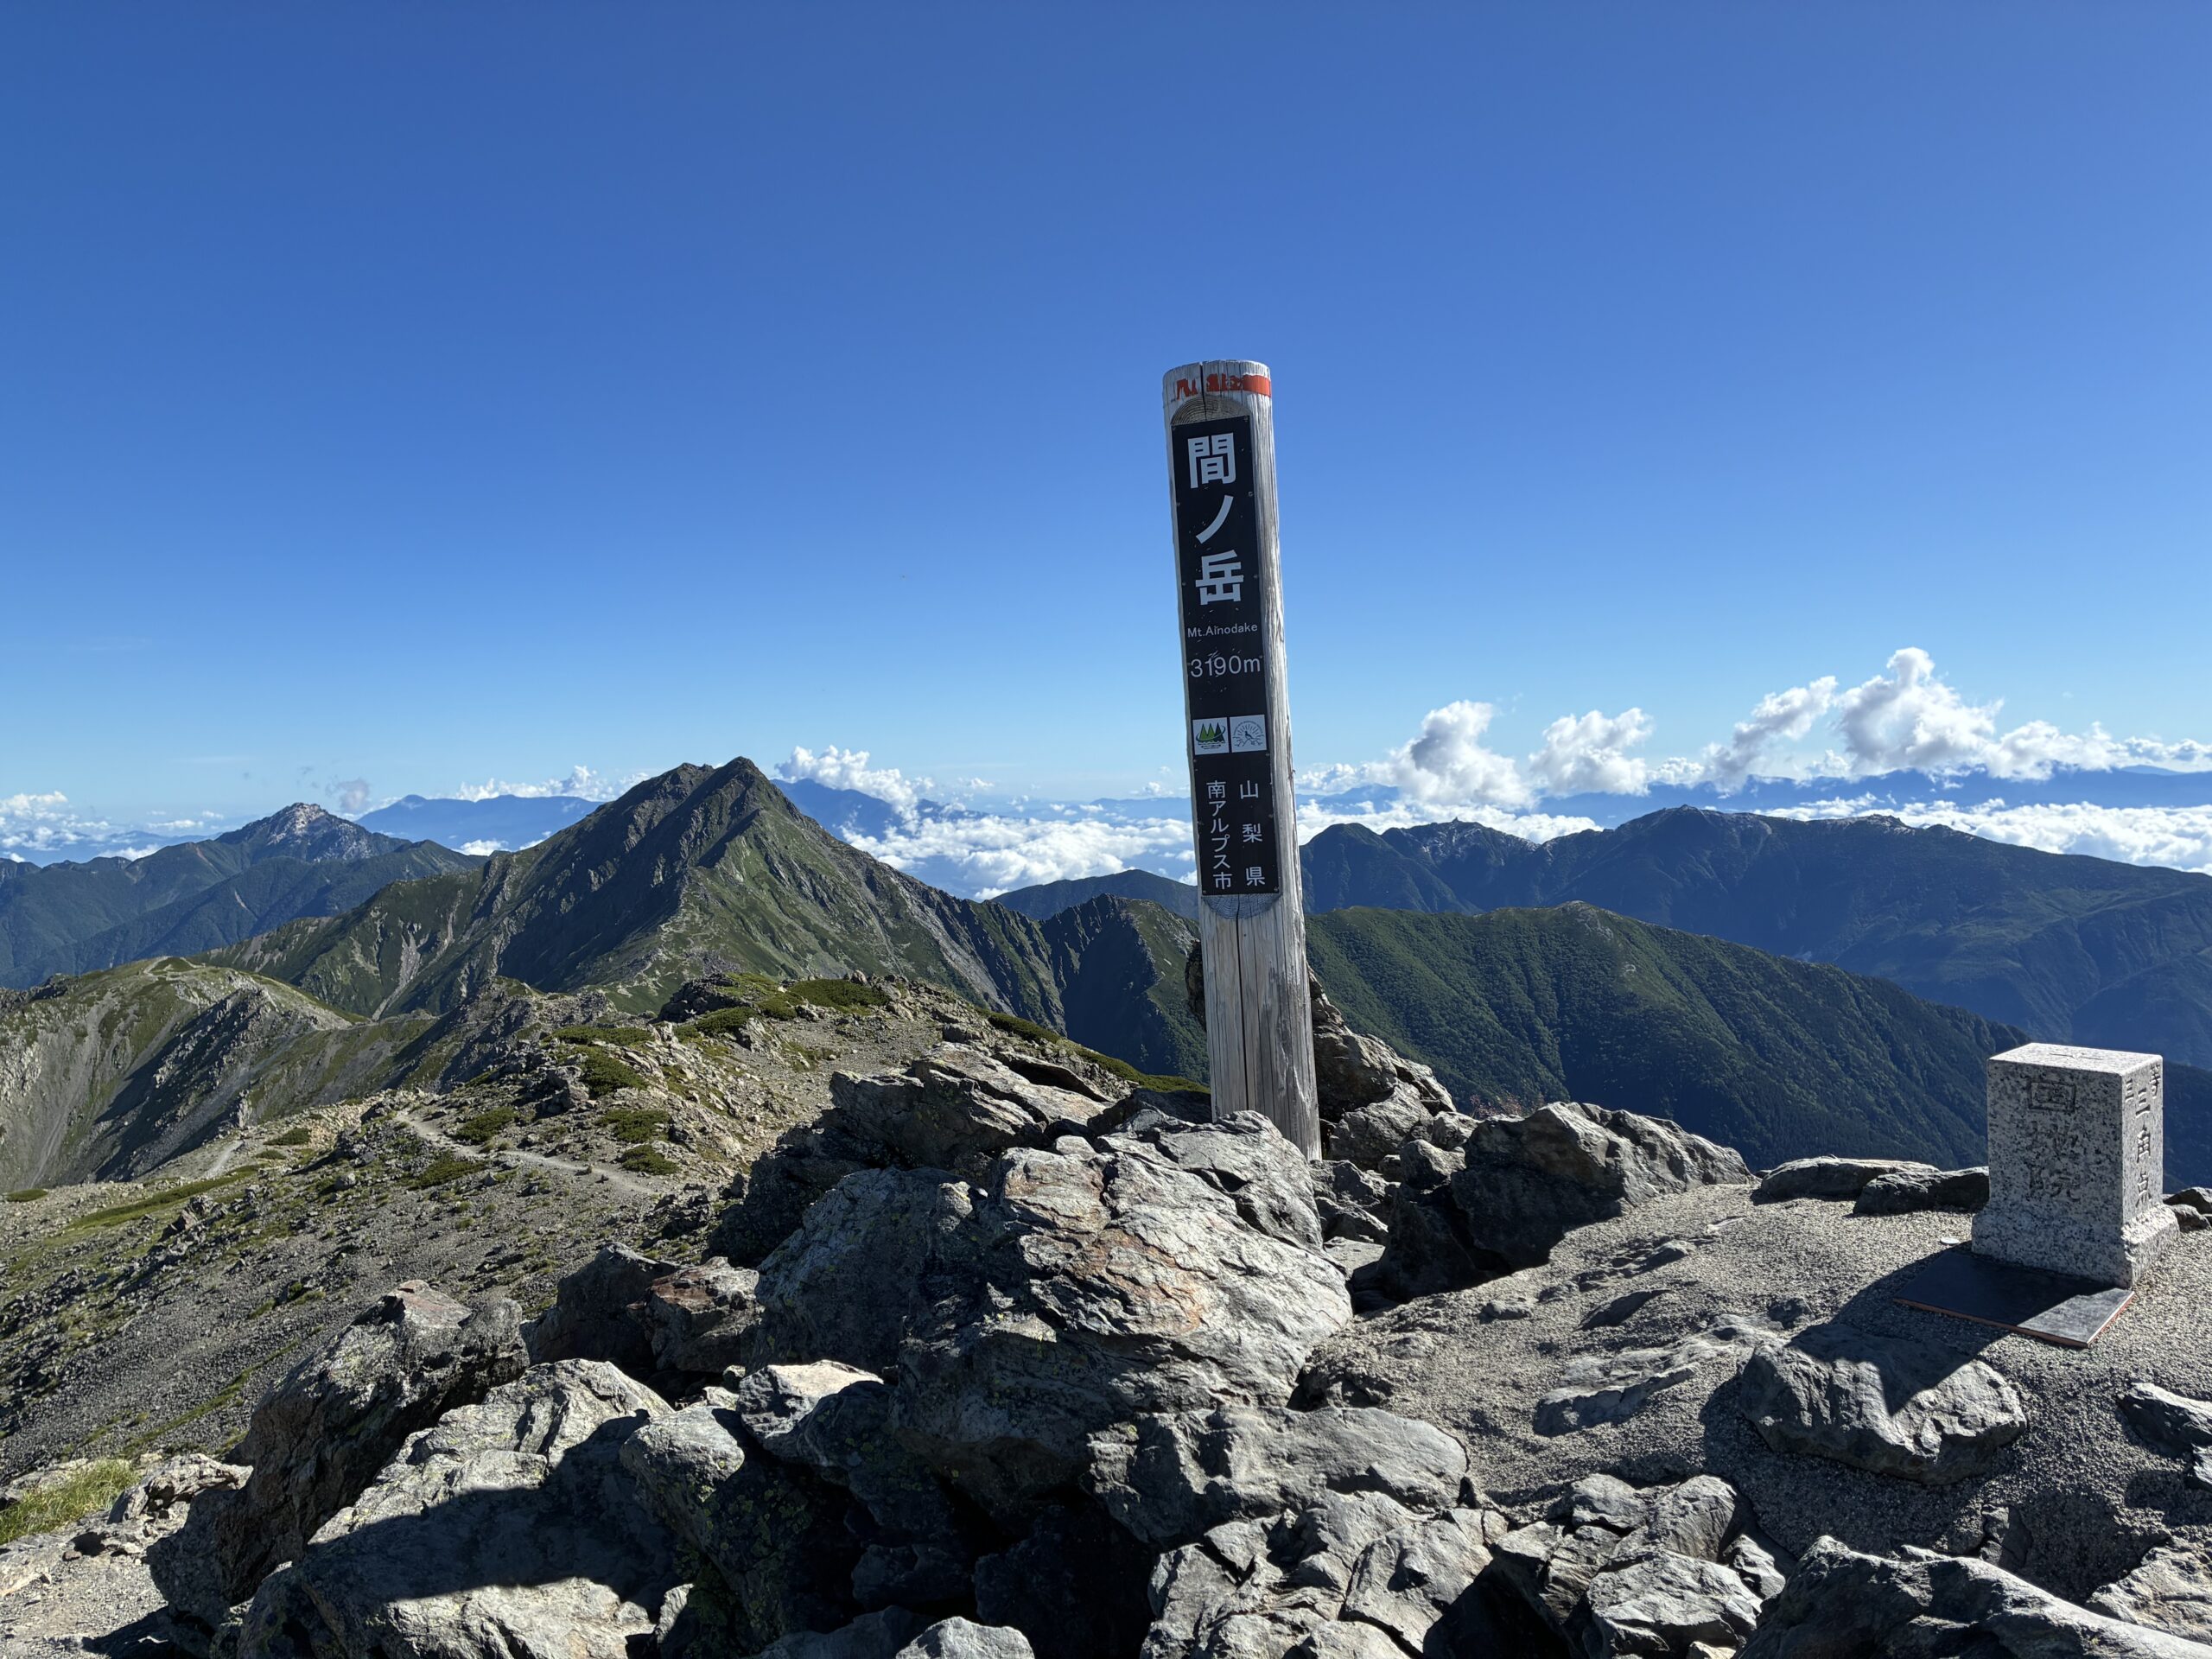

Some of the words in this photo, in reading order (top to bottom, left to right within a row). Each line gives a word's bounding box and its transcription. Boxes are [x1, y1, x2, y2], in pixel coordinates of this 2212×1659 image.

[1186, 432, 1244, 606] 間ノ岳
[1190, 655, 1261, 677] 3190m
[1206, 779, 1233, 890] 南アルプス市
[1239, 779, 1266, 887] 山梨県
